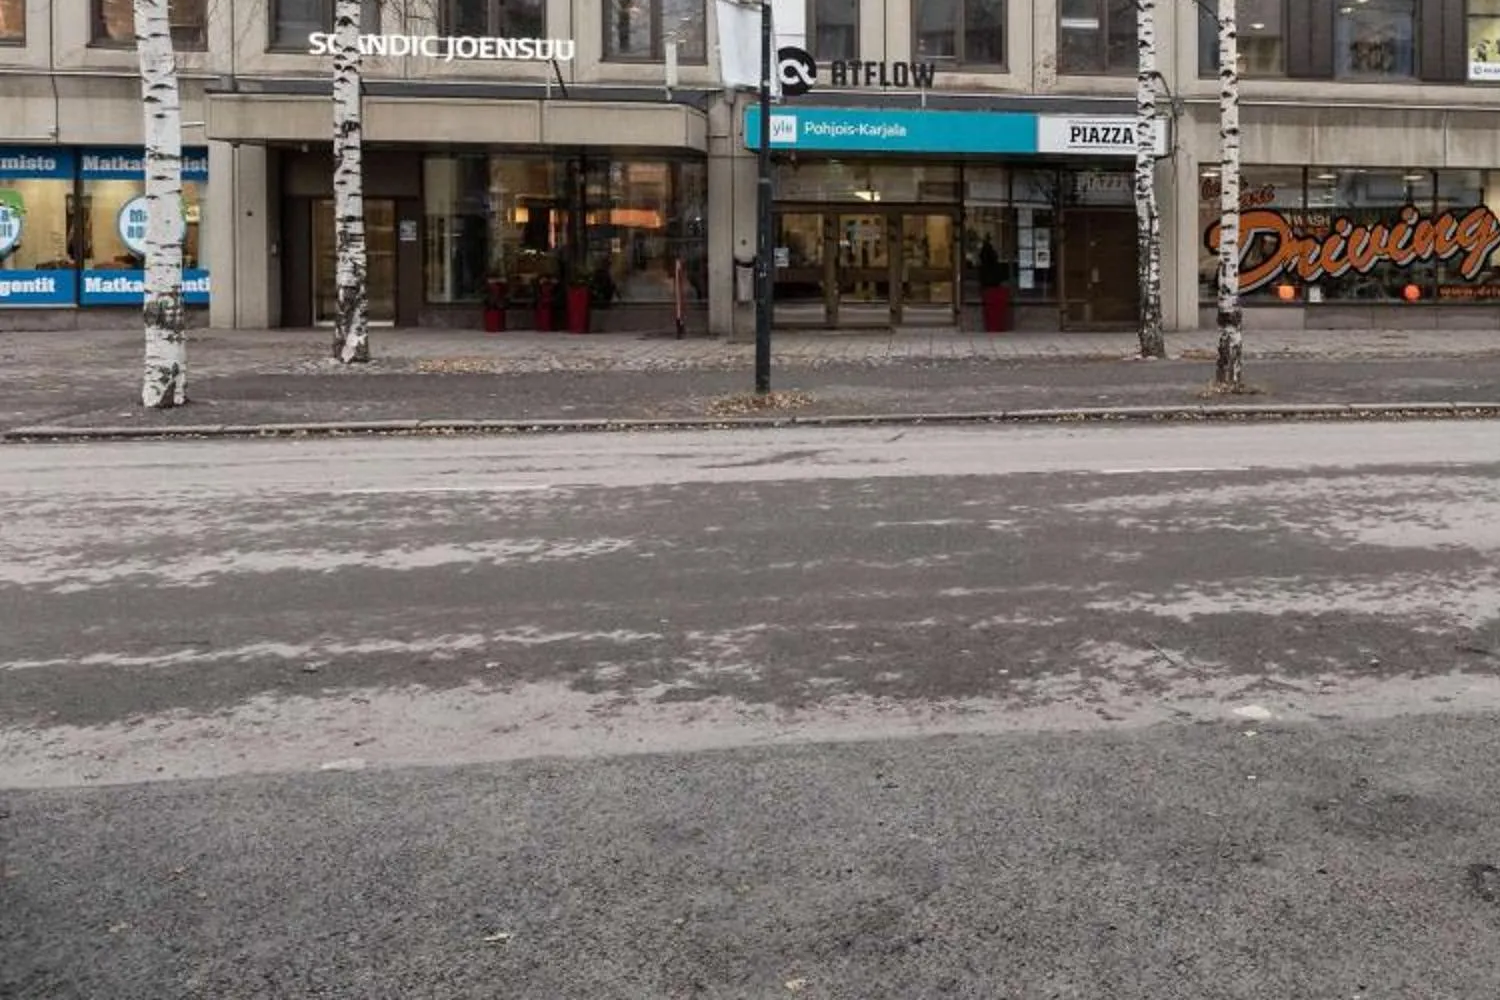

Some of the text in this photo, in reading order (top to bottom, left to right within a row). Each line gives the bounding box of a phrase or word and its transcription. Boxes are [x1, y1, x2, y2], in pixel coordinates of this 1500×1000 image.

[443, 35, 576, 62] JOENSUU
[831, 59, 935, 89] ATFLOW
[804, 121, 907, 139] Pohjois-Karjala
[1069, 126, 1135, 145] PIAZZA
